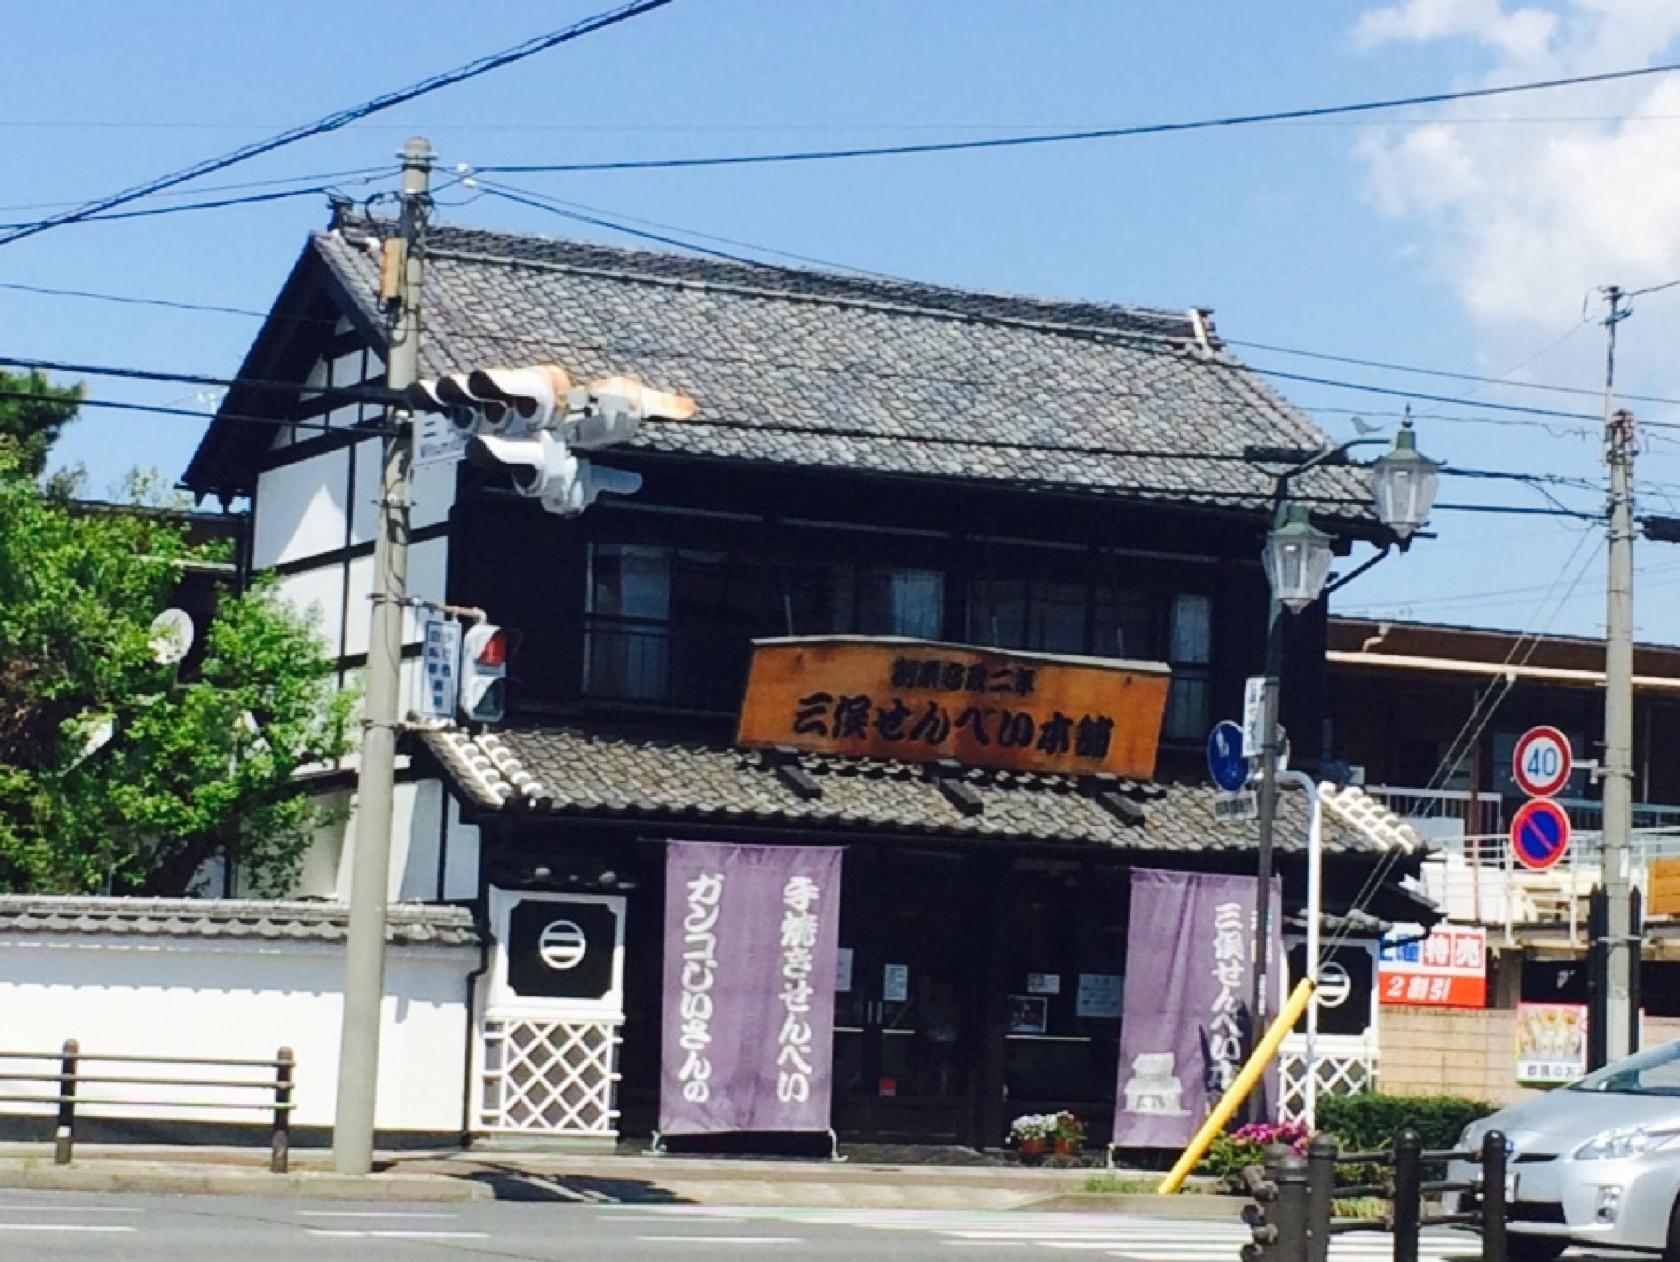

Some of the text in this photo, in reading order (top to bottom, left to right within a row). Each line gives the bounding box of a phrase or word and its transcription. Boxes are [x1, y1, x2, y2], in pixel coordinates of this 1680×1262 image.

[1527, 747, 1558, 776] 40
[776, 876, 820, 1103] 手焼きせんべい
